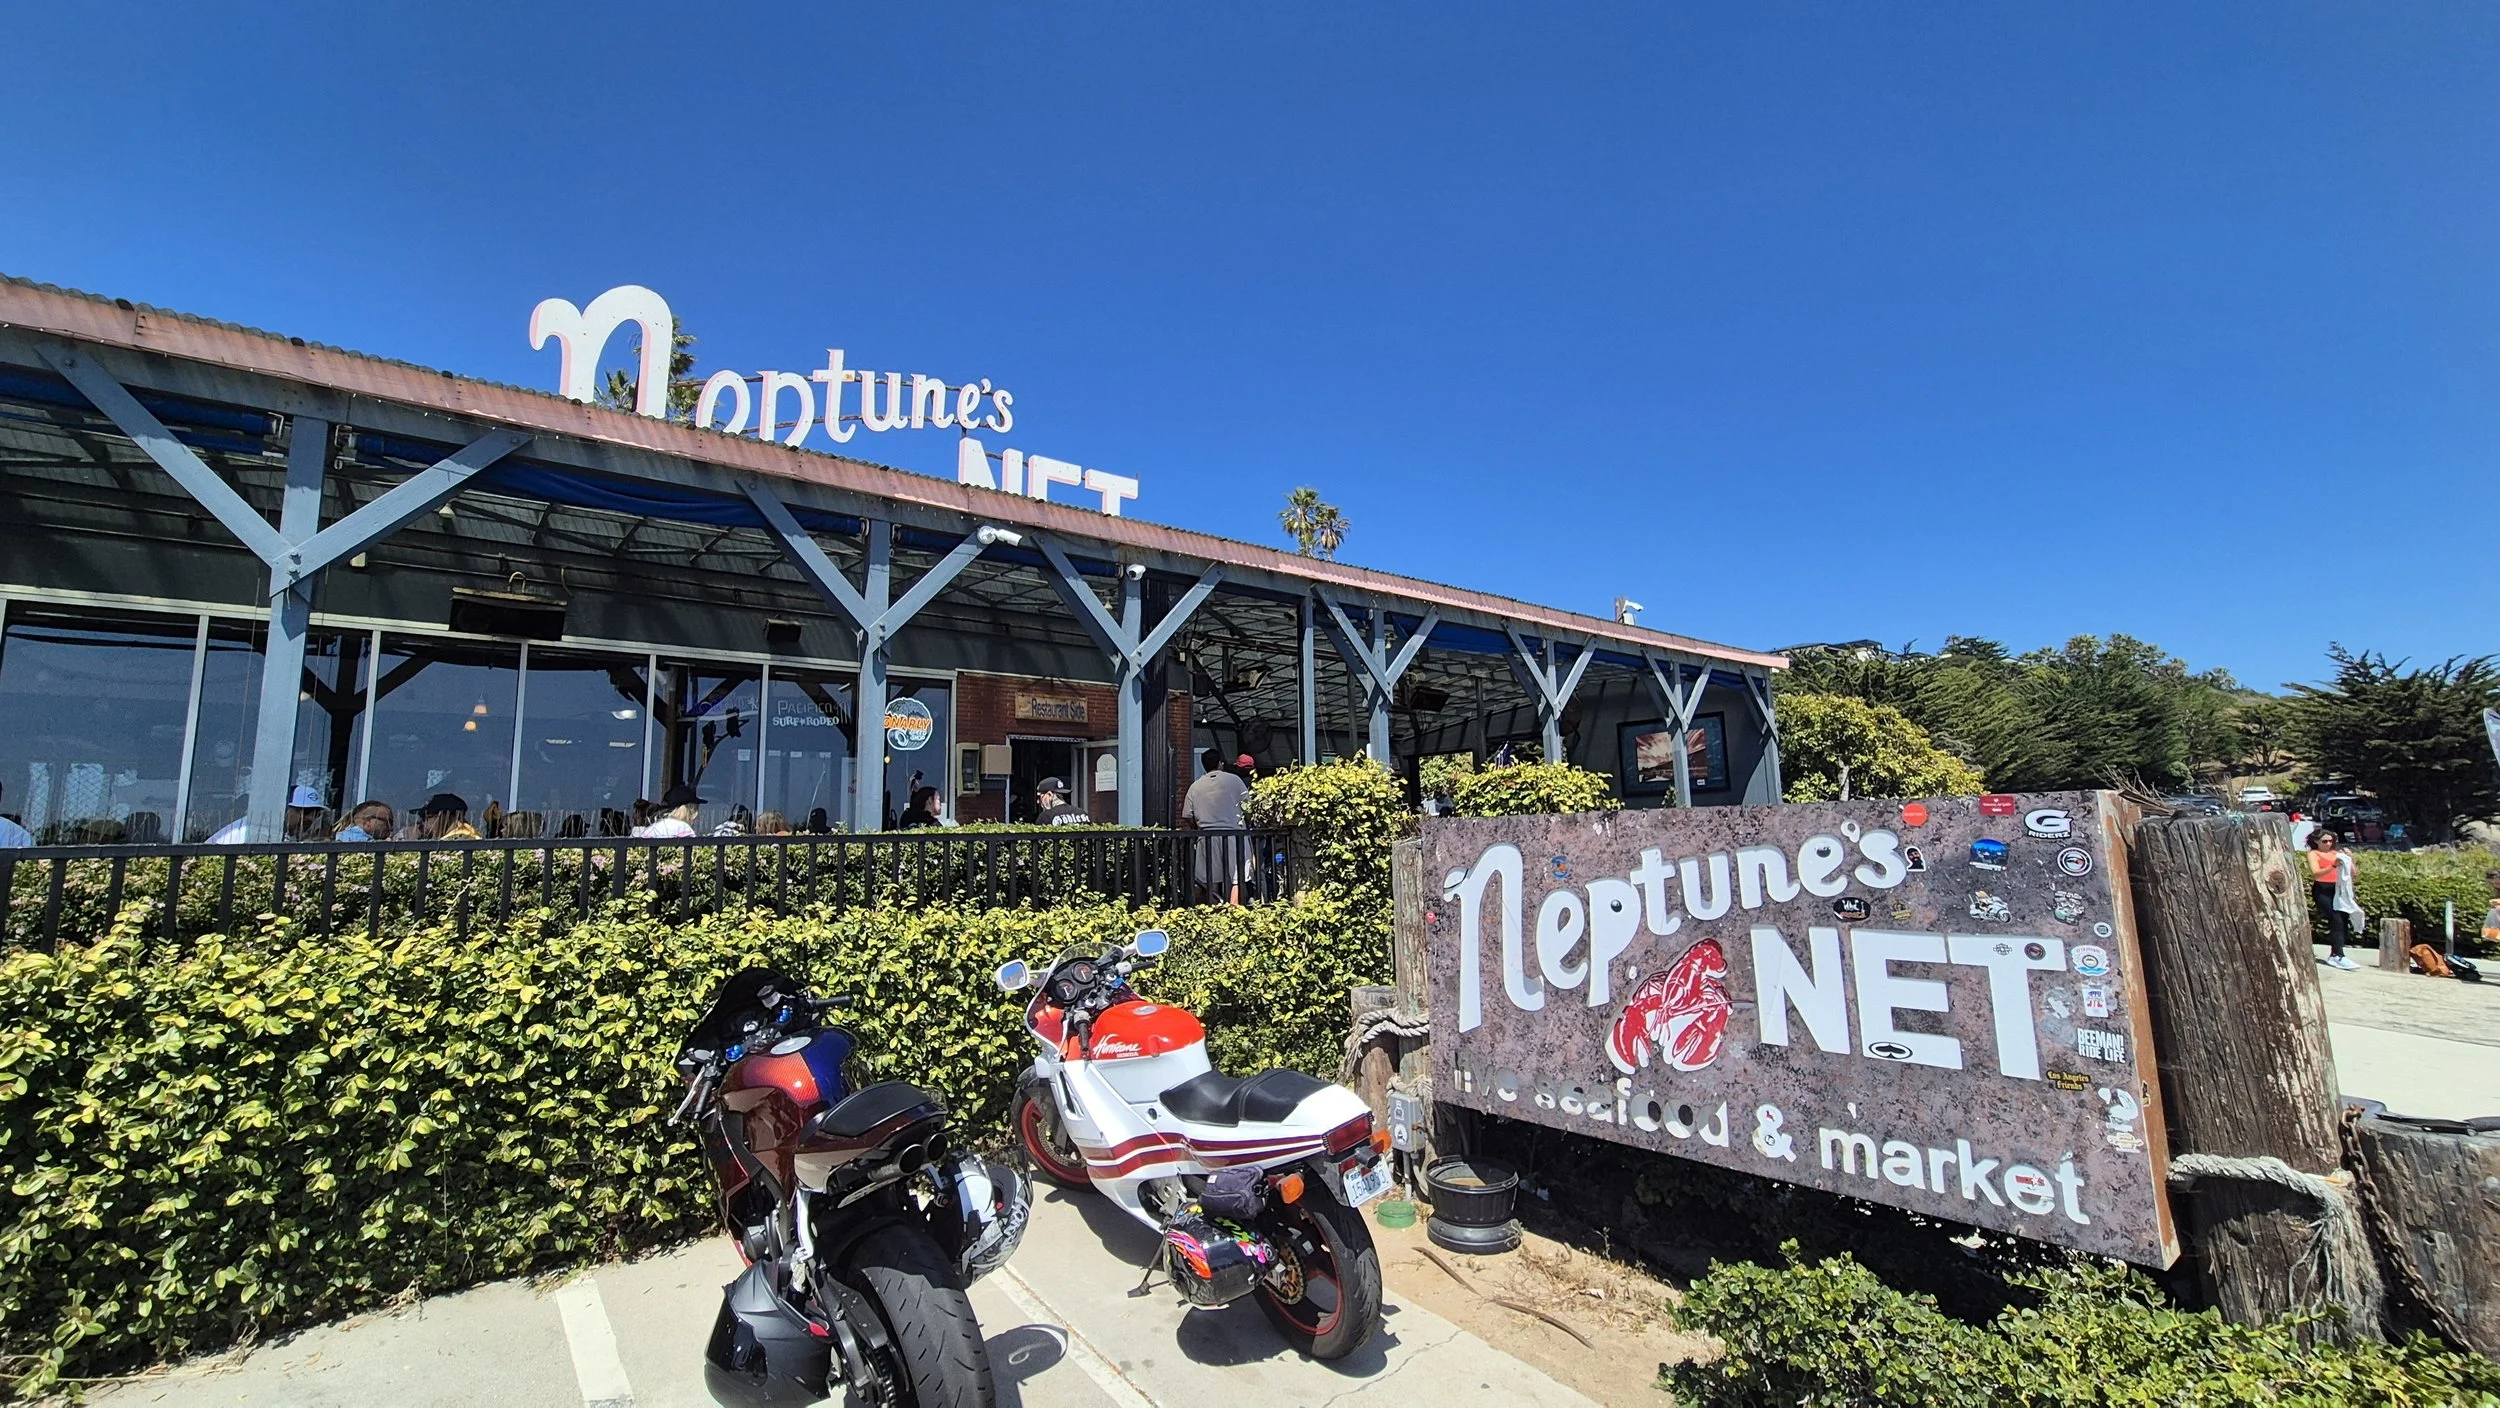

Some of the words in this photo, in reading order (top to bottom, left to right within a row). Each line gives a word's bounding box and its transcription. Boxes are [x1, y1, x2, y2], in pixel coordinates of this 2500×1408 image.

[773, 716, 800, 727] SURF
[806, 716, 839, 727] RODEO
[1443, 819, 1906, 1032] Neptune's
[1750, 925, 2067, 1081] NET
[1752, 1104, 1797, 1163] &
[1819, 1126, 2090, 1226] market
